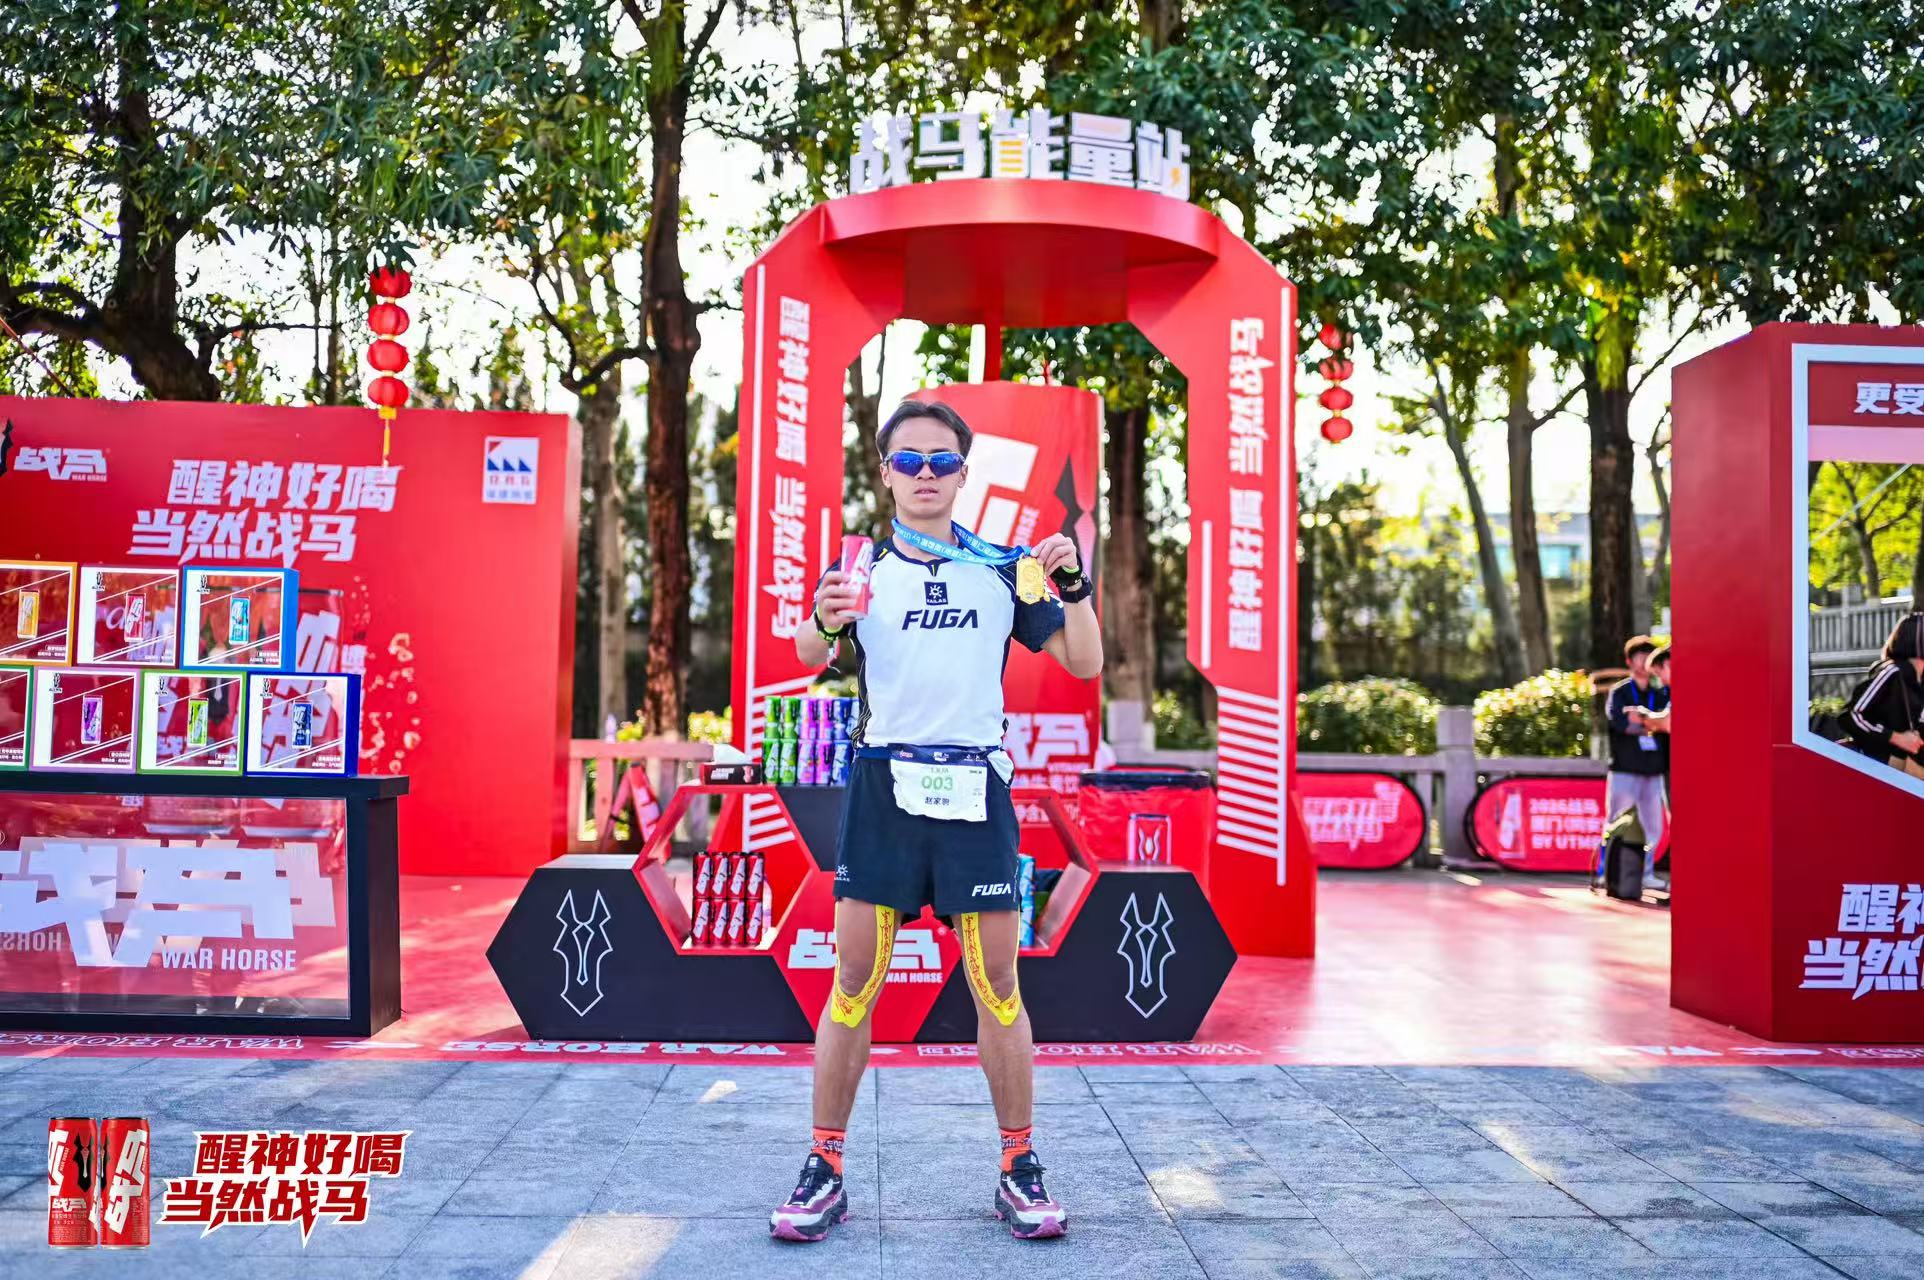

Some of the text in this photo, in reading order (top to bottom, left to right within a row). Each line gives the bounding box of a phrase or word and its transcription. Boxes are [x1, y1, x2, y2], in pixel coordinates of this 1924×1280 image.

[849, 108, 1191, 201] 战马能量站
[775, 296, 811, 465] 醒神好喝
[1227, 317, 1275, 477] 当然战马
[1853, 382, 1924, 415] 更受
[13, 447, 107, 480] 战马
[166, 458, 403, 512] 醒神好喝
[126, 508, 357, 570] 当然战马
[902, 609, 979, 630] FUGA
[921, 776, 953, 791] 003
[972, 883, 1012, 897] FUGA
[162, 948, 296, 971] WAR HORSE
[909, 972, 943, 983] HORSE
[441, 1041, 787, 1055] WAR HORSE
[918, 1043, 1123, 1056] HOSE
